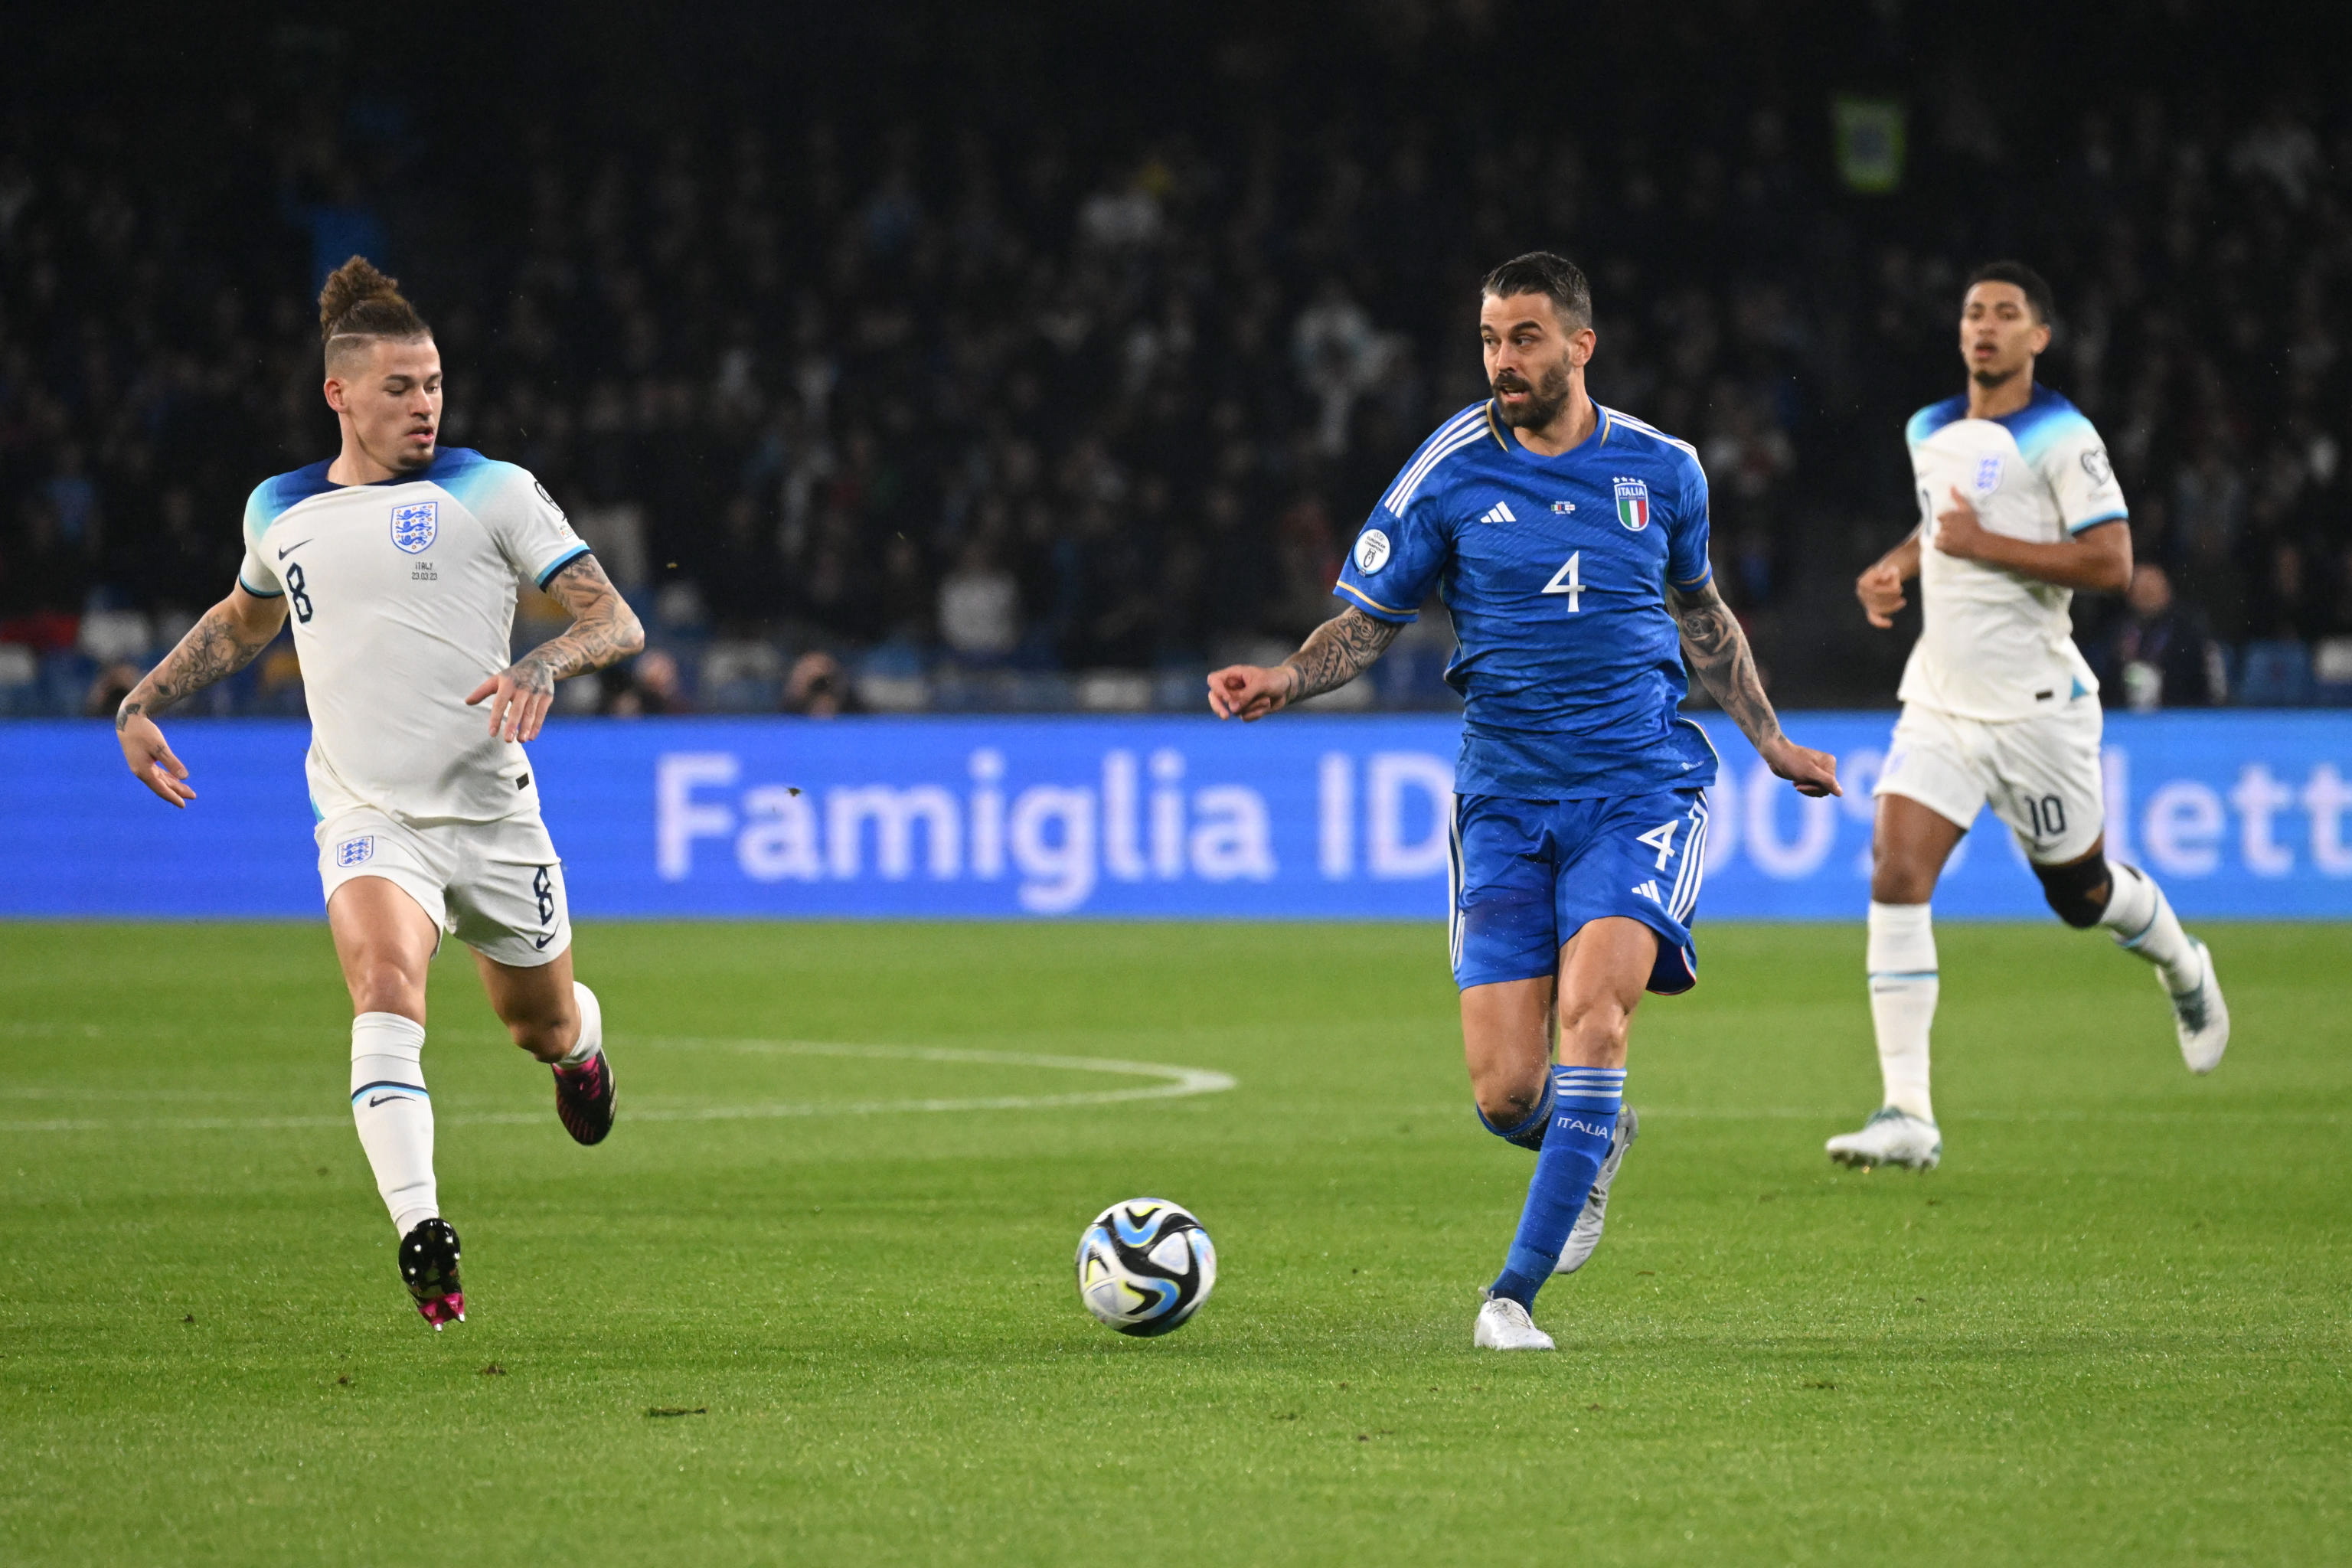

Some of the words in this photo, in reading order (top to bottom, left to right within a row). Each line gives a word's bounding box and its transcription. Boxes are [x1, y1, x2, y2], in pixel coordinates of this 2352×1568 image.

[1617, 486, 1645, 497] ITALIA
[415, 560, 433, 570] ITALY
[1540, 550, 1586, 612] 4
[286, 561, 313, 624] 8
[656, 747, 1277, 913] Famiglia
[1319, 751, 1457, 878] ID
[2024, 793, 2067, 838] 10
[1635, 818, 1679, 871] 4
[532, 865, 555, 926] 8
[1557, 1116, 1609, 1139] ITALIA
